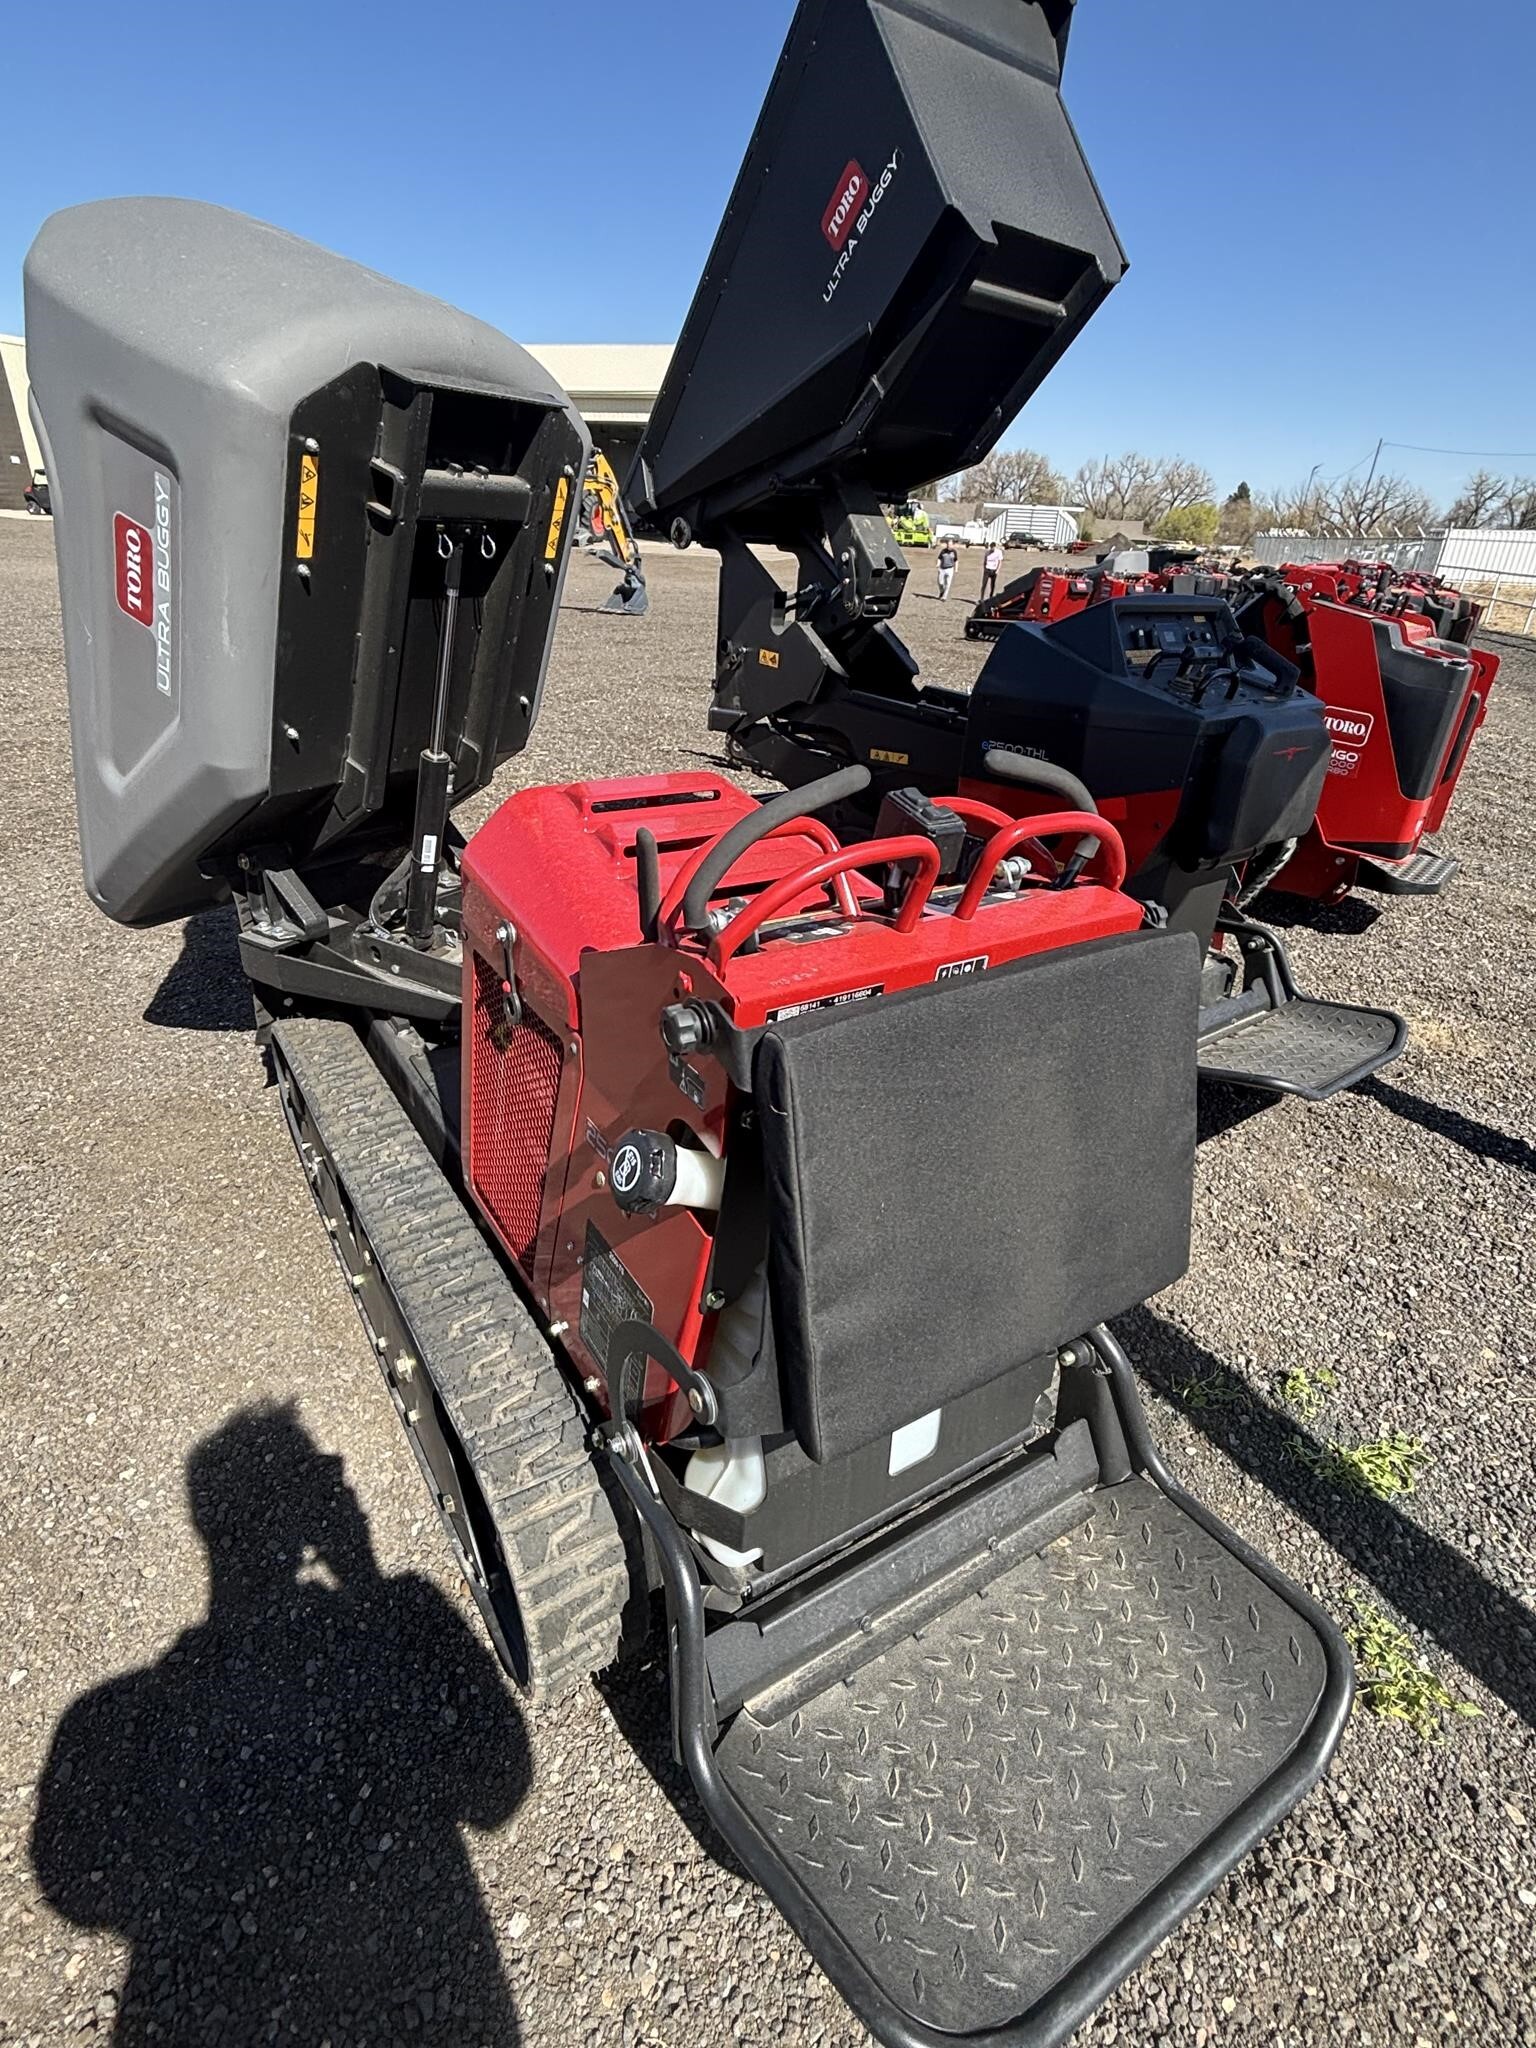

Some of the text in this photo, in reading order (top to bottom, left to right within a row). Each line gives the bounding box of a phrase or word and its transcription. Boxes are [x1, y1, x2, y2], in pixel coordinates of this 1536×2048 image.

[822, 148, 899, 303] ULTRA BUGGY
[827, 174, 861, 238] TORO
[125, 528, 142, 612] TORO
[155, 480, 170, 692] ULTRA BUGGY
[1324, 716, 1366, 736] TORO
[1329, 758, 1355, 770] 000
